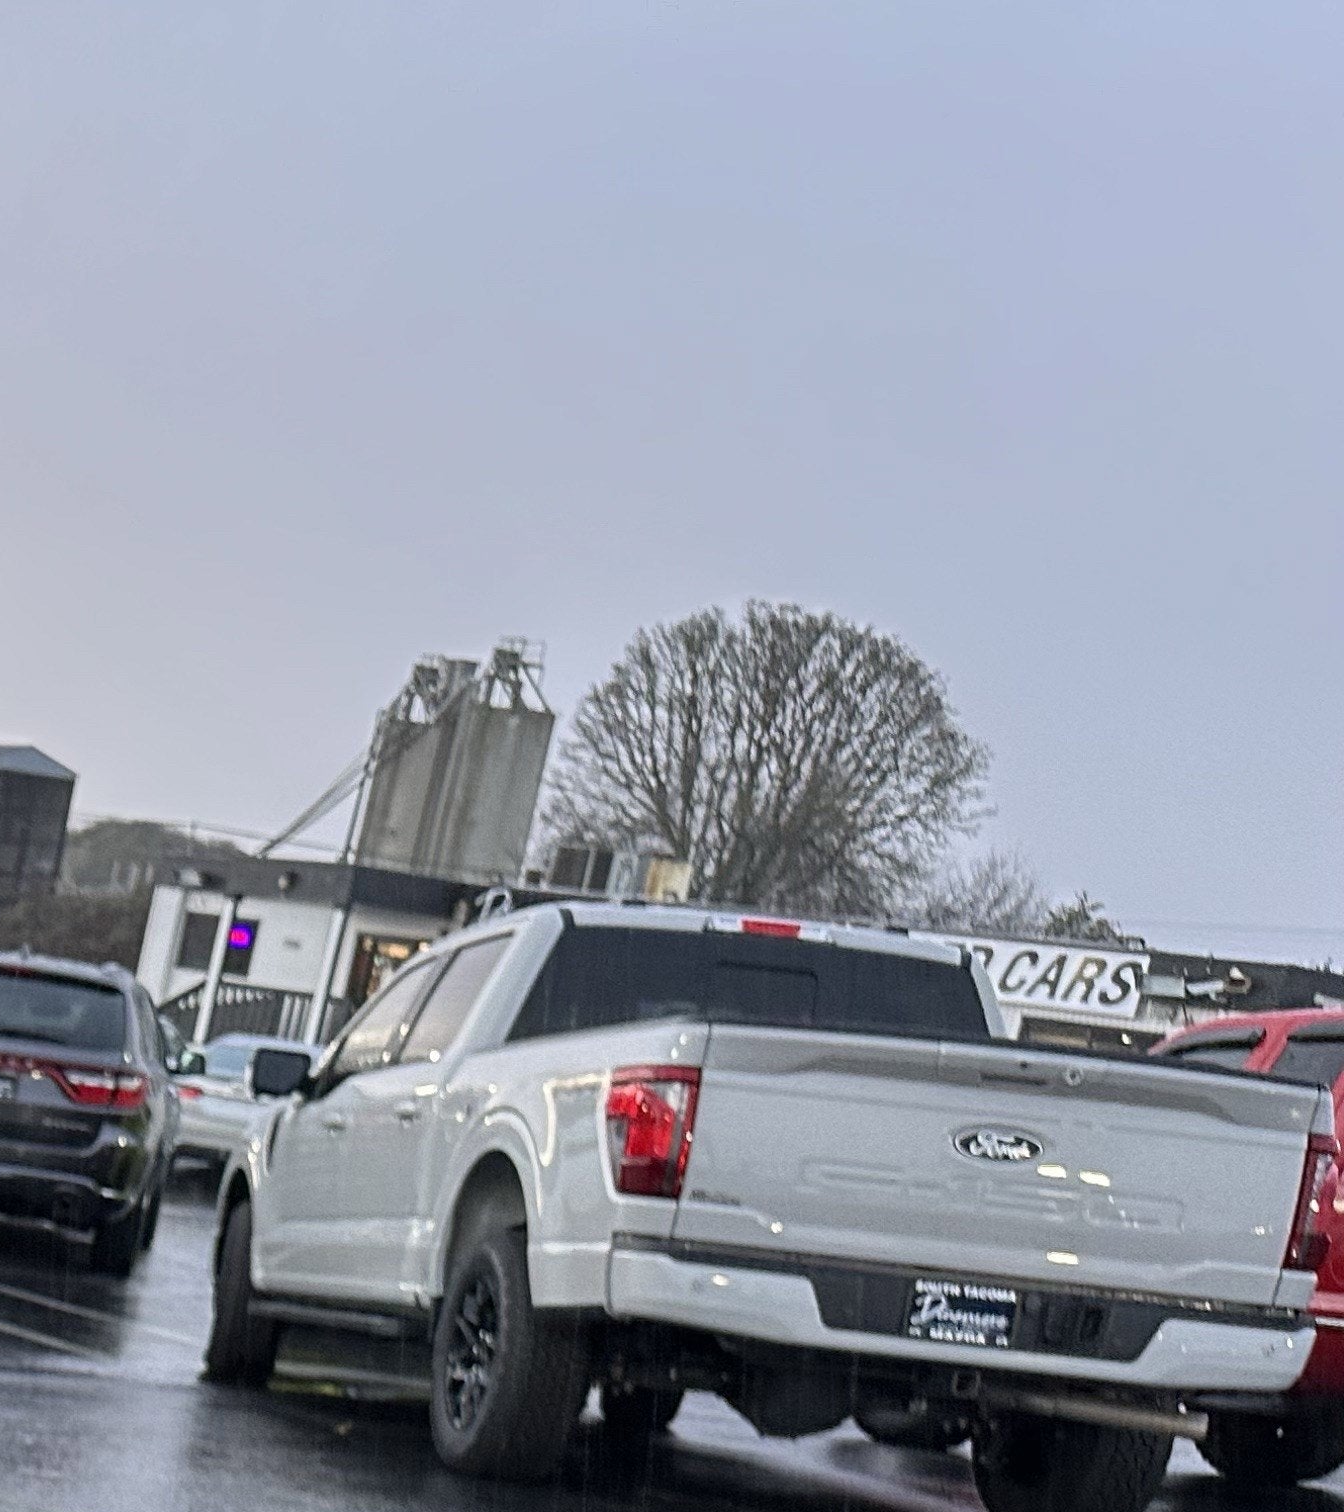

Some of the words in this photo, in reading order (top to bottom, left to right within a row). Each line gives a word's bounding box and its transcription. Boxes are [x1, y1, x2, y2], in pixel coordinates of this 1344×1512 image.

[996, 949, 1144, 1006] CARS
[962, 1126, 1037, 1161] Ford
[914, 1278, 962, 1297] SOUTH
[963, 1283, 1017, 1304] TACOMA
